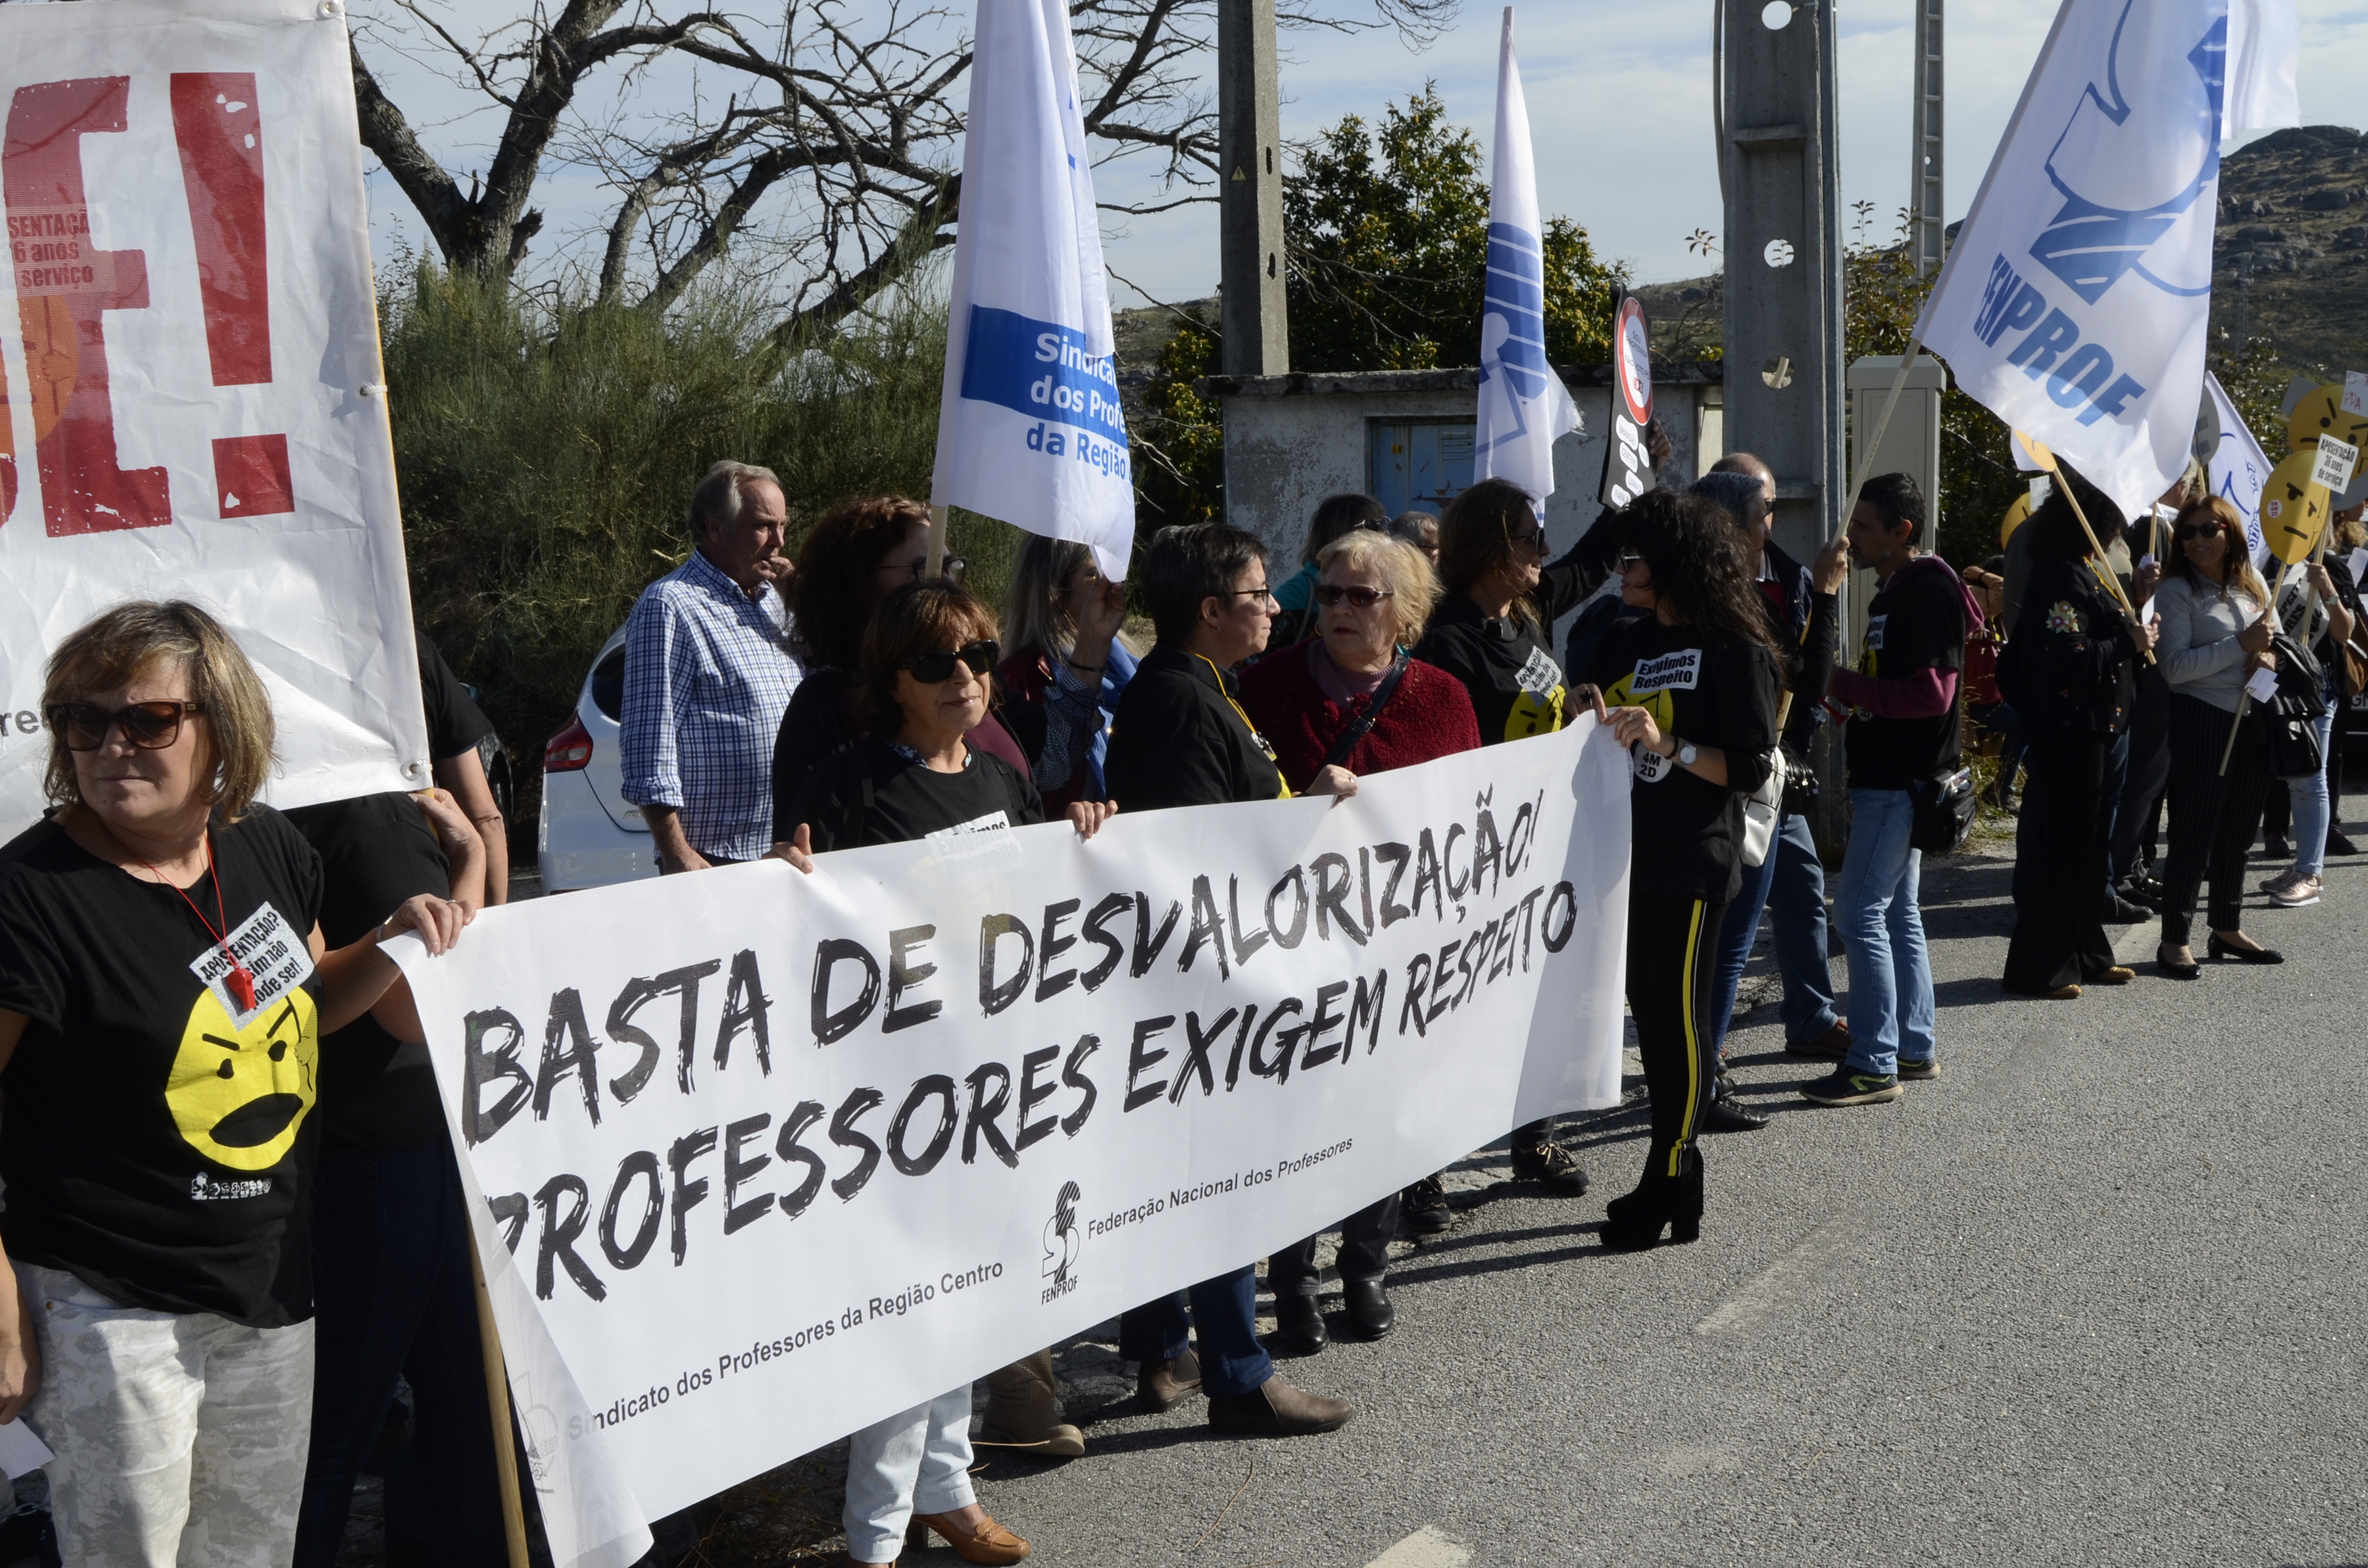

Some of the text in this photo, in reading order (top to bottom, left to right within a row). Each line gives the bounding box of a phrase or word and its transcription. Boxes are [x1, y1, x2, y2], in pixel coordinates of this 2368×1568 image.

[31, 241, 79, 263] anos
[21, 263, 94, 289] serviço
[1030, 375, 1126, 434] dos Profe
[1026, 422, 1126, 480] da Região
[1633, 669, 1693, 689] Respeito
[1638, 655, 1696, 676] Exigimos
[1639, 764, 1657, 778] 2D
[1643, 751, 1661, 767] 4M
[200, 911, 280, 981] APOSENTAÇÃO?
[265, 940, 288, 964] não
[461, 782, 1544, 1151] BASTA DE DESVALORIZAÇÃO!
[253, 956, 304, 1010] ode ser!
[1122, 967, 1387, 1113] EXIGEM
[1399, 881, 1578, 1038] RESPEITO
[1089, 1137, 1353, 1239] Federação Nacional dos Professores
[1041, 1275, 1078, 1305] FENPROF
[677, 1368, 712, 1396] dos
[719, 1319, 835, 1379] Professores
[841, 1307, 863, 1330] da
[869, 1283, 935, 1319] Região
[941, 1262, 1003, 1294] Centro
